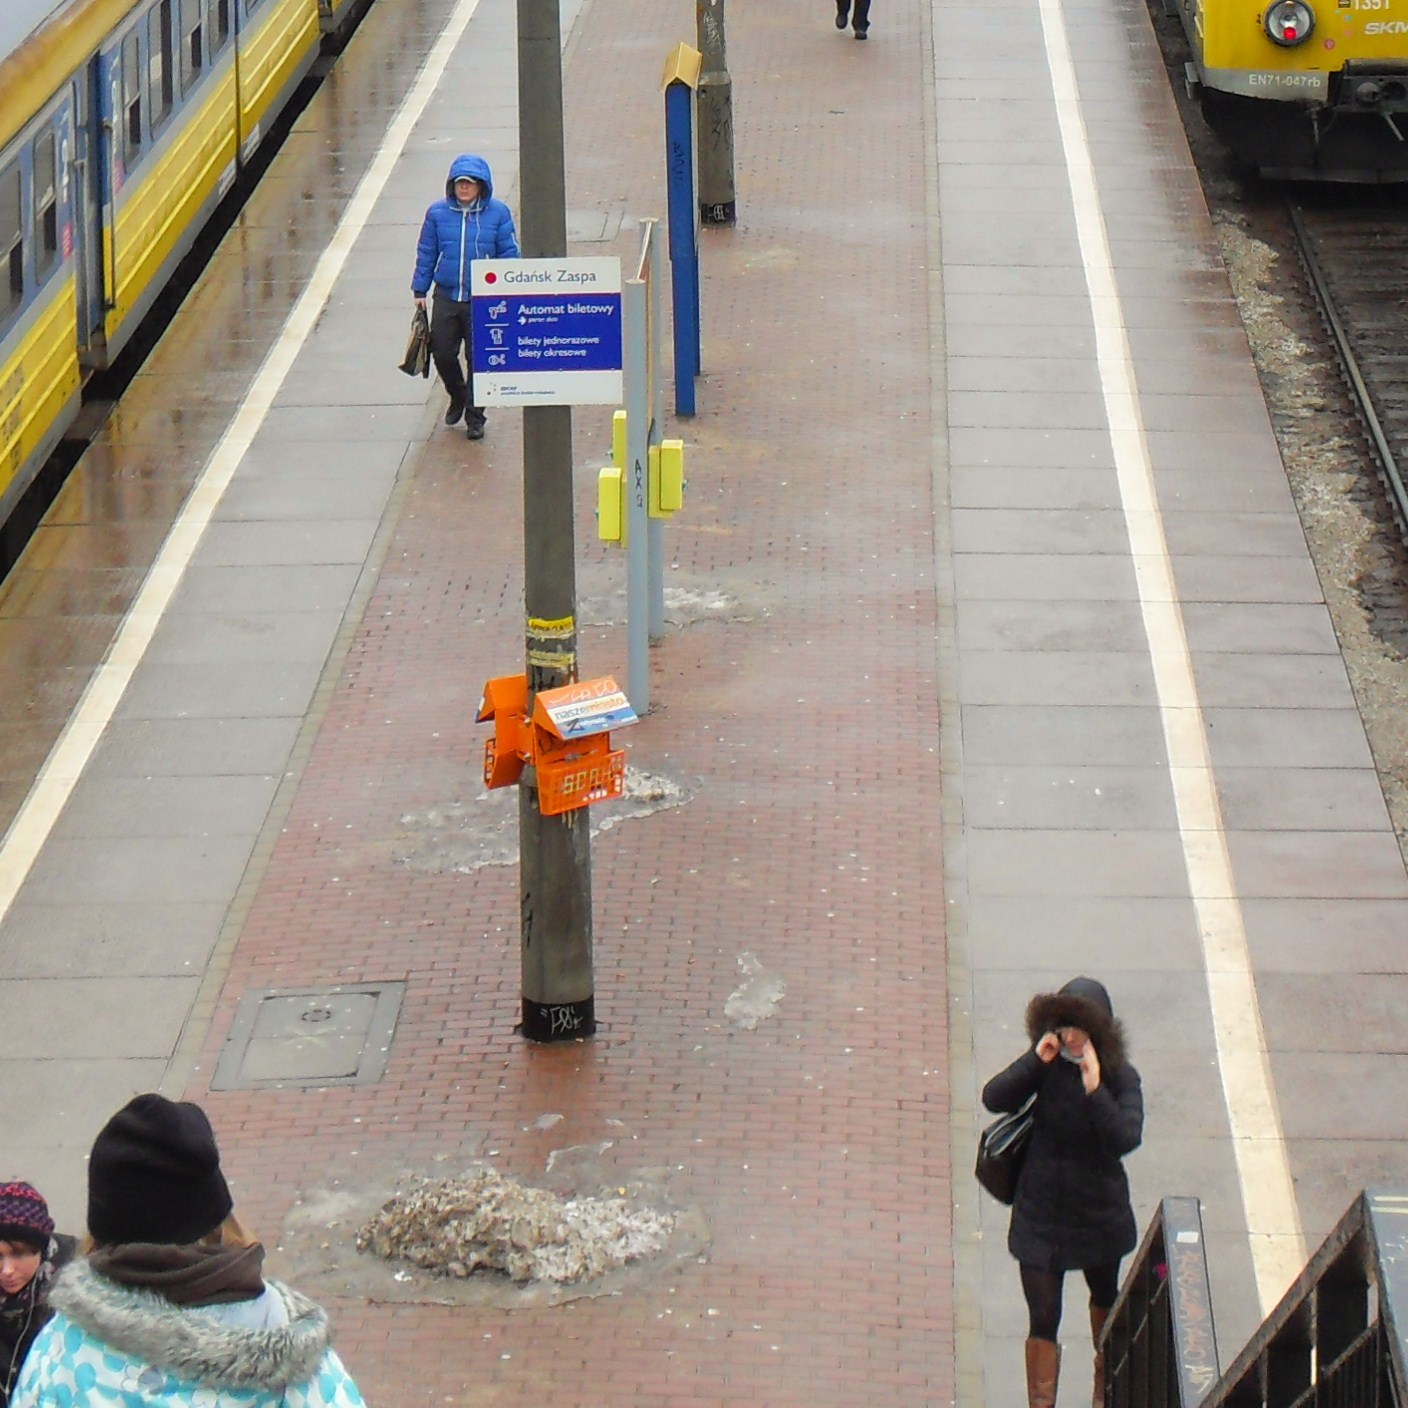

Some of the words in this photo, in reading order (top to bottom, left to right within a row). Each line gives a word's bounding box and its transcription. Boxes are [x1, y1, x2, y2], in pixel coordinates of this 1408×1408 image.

[503, 270, 553, 284] Gdańsk
[557, 269, 597, 285] Zaspa
[517, 304, 565, 315] Automat
[567, 303, 614, 316] biletowy
[517, 336, 541, 347] bilety
[517, 348, 541, 359] bilety
